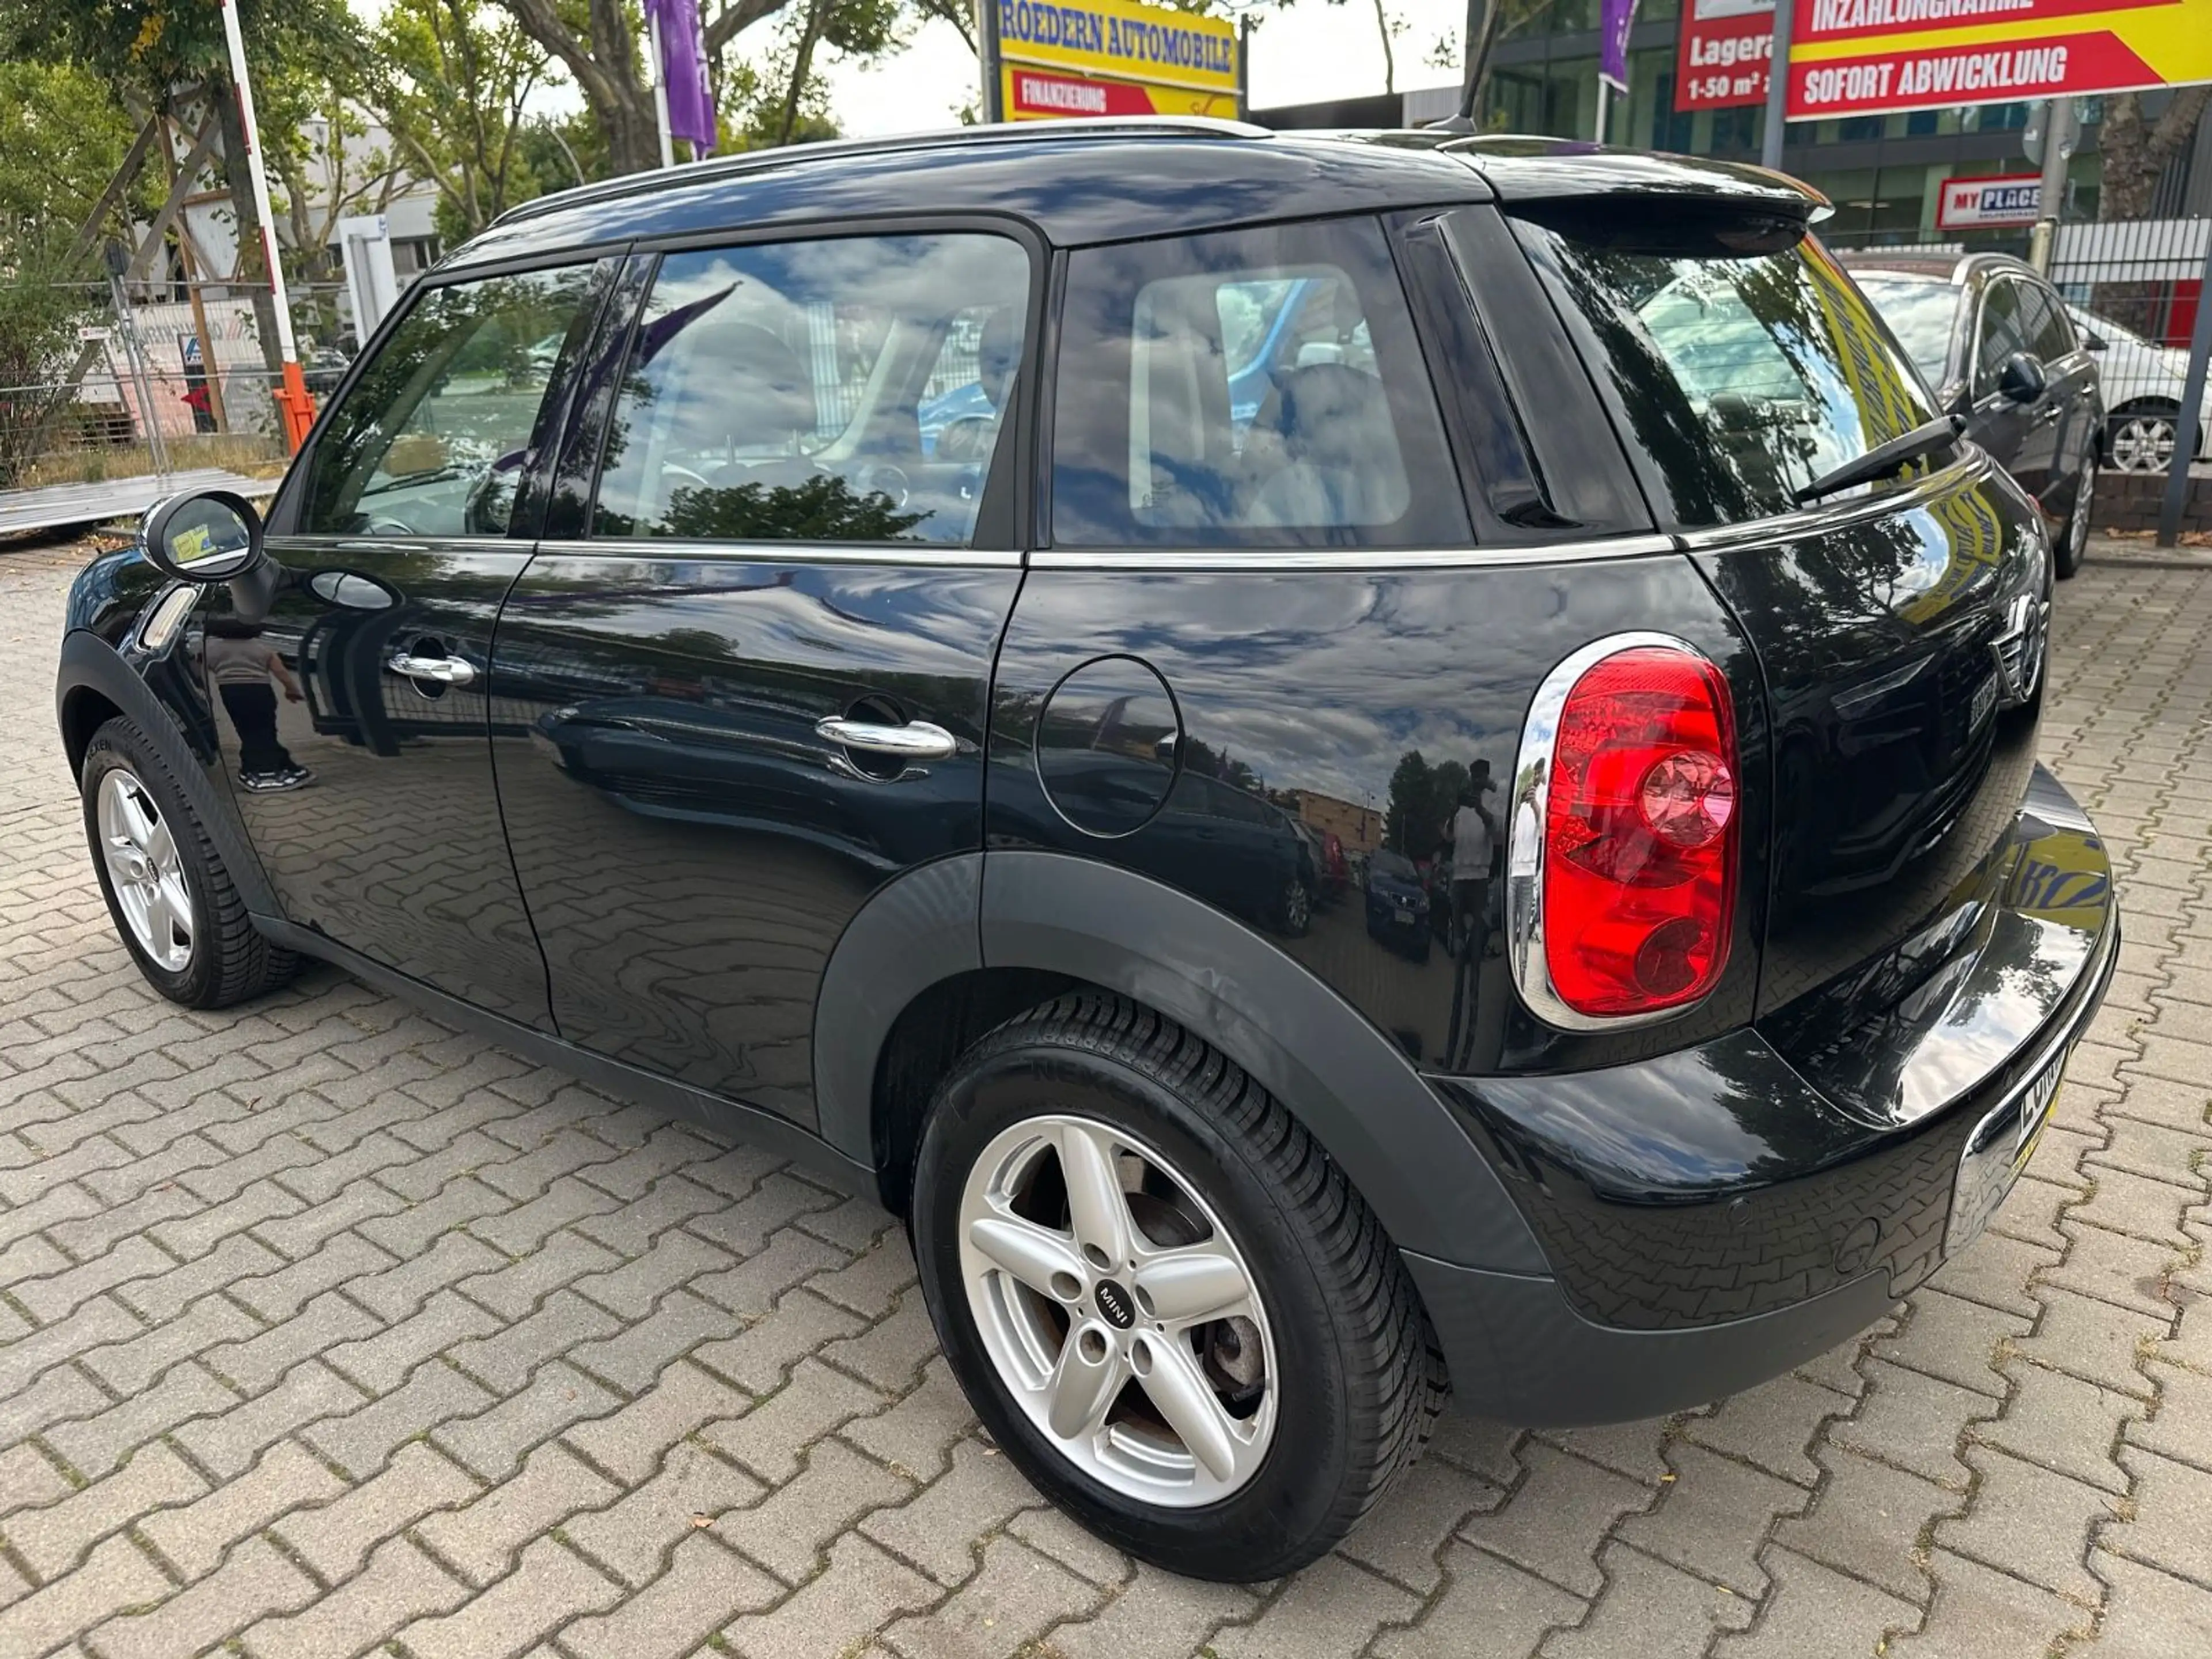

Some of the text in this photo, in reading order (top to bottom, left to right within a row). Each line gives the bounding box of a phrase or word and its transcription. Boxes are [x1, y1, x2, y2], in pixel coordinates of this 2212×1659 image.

[1001, 0, 1233, 73] ROEDERN AUTOMOBILE
[1688, 76, 1730, 100] 1-50
[1804, 63, 1895, 105] SOFORT
[1897, 46, 2068, 96] ABWICKLUNG
[1021, 77, 1107, 113] FINANZIERUNG
[1100, 1287, 1128, 1323] MINI
